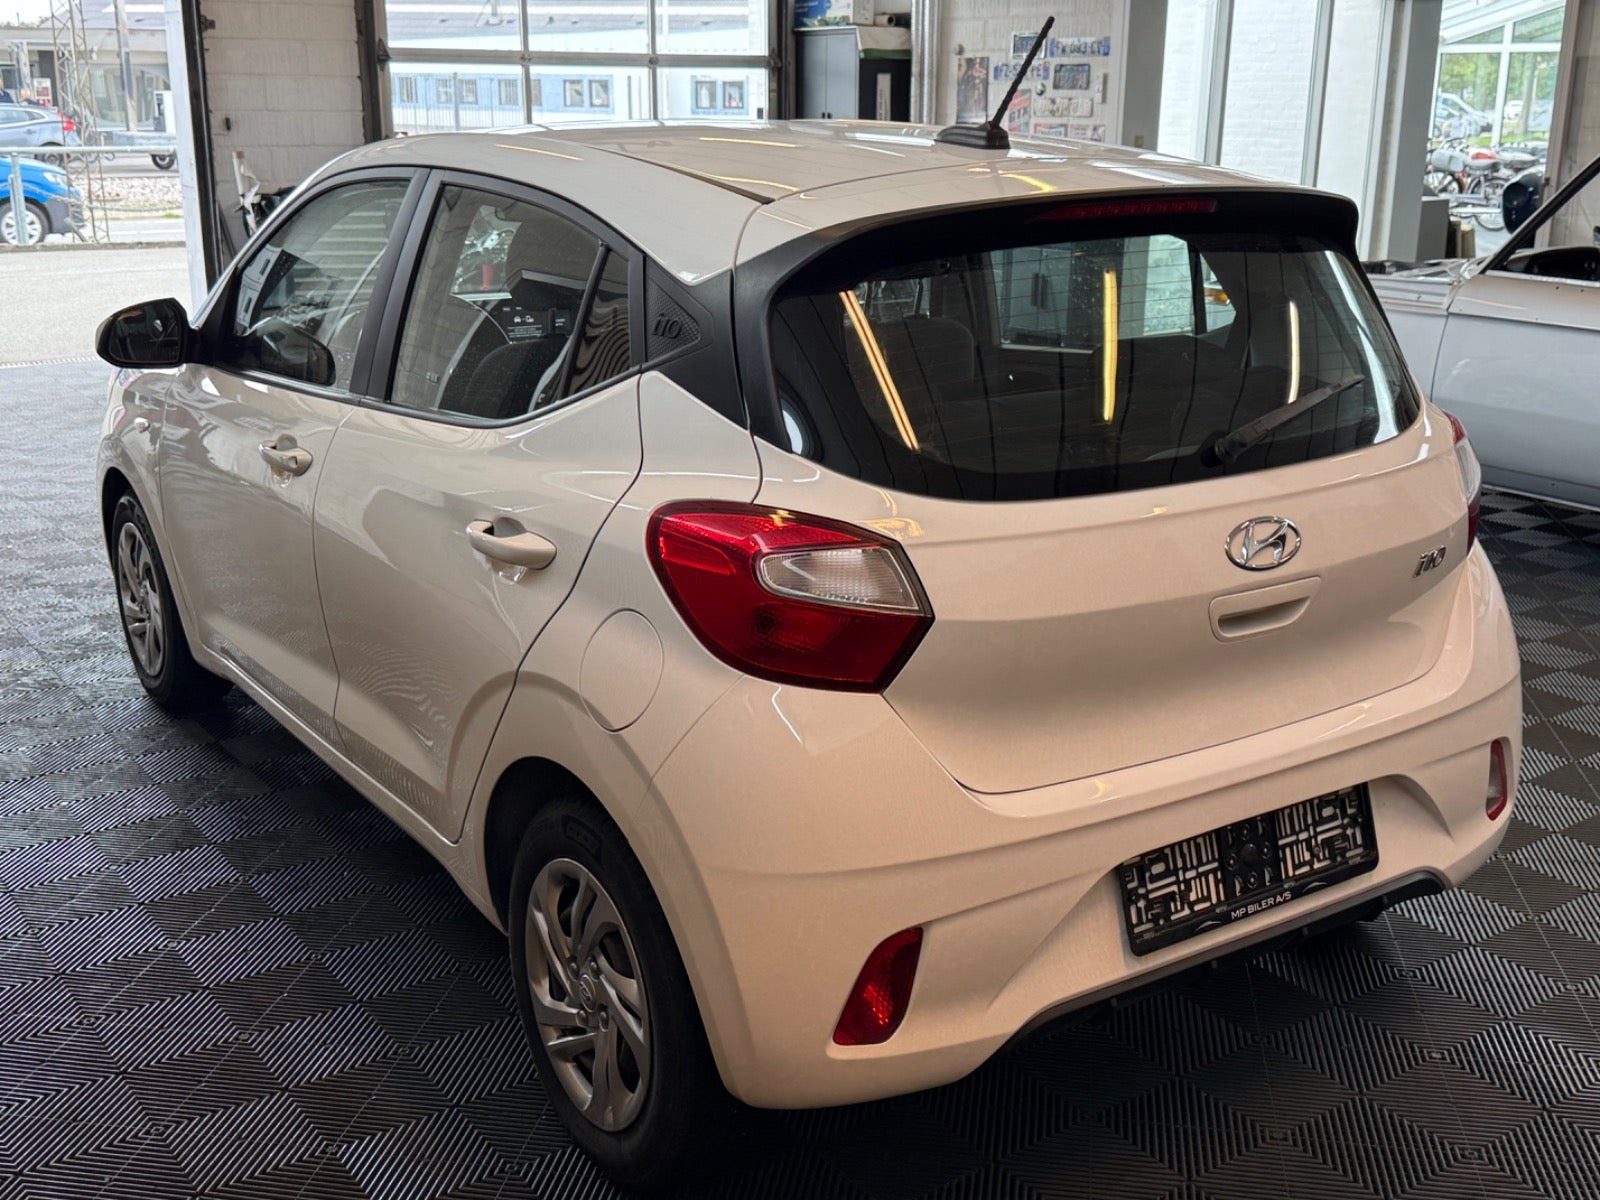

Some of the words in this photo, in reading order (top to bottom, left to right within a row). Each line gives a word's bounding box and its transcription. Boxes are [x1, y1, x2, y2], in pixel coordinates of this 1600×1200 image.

[652, 312, 682, 340] i10
[1413, 545, 1447, 578] i10
[1231, 907, 1246, 920] MP
[1247, 897, 1275, 914] BILER
[1275, 891, 1292, 904] A/S
